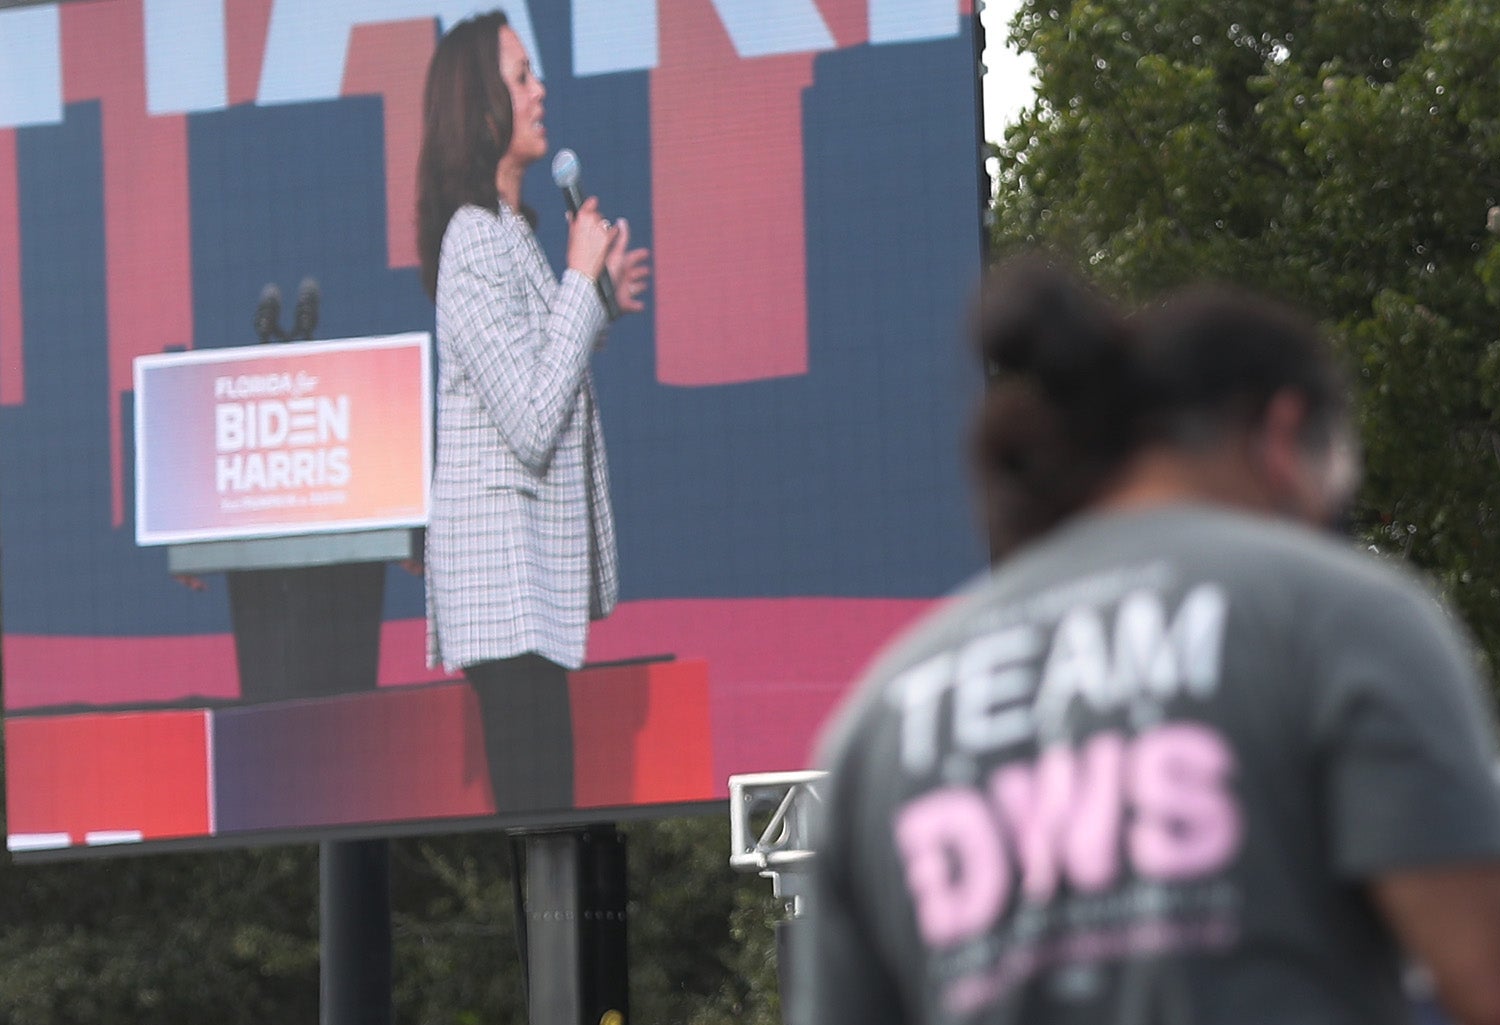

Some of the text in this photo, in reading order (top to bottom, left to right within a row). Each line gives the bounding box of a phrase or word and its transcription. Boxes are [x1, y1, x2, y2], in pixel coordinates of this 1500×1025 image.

[215, 394, 350, 452] BIDEN
[215, 446, 353, 494] HARRIS
[884, 583, 1230, 776] TEAM
[894, 718, 1244, 950] DWS
